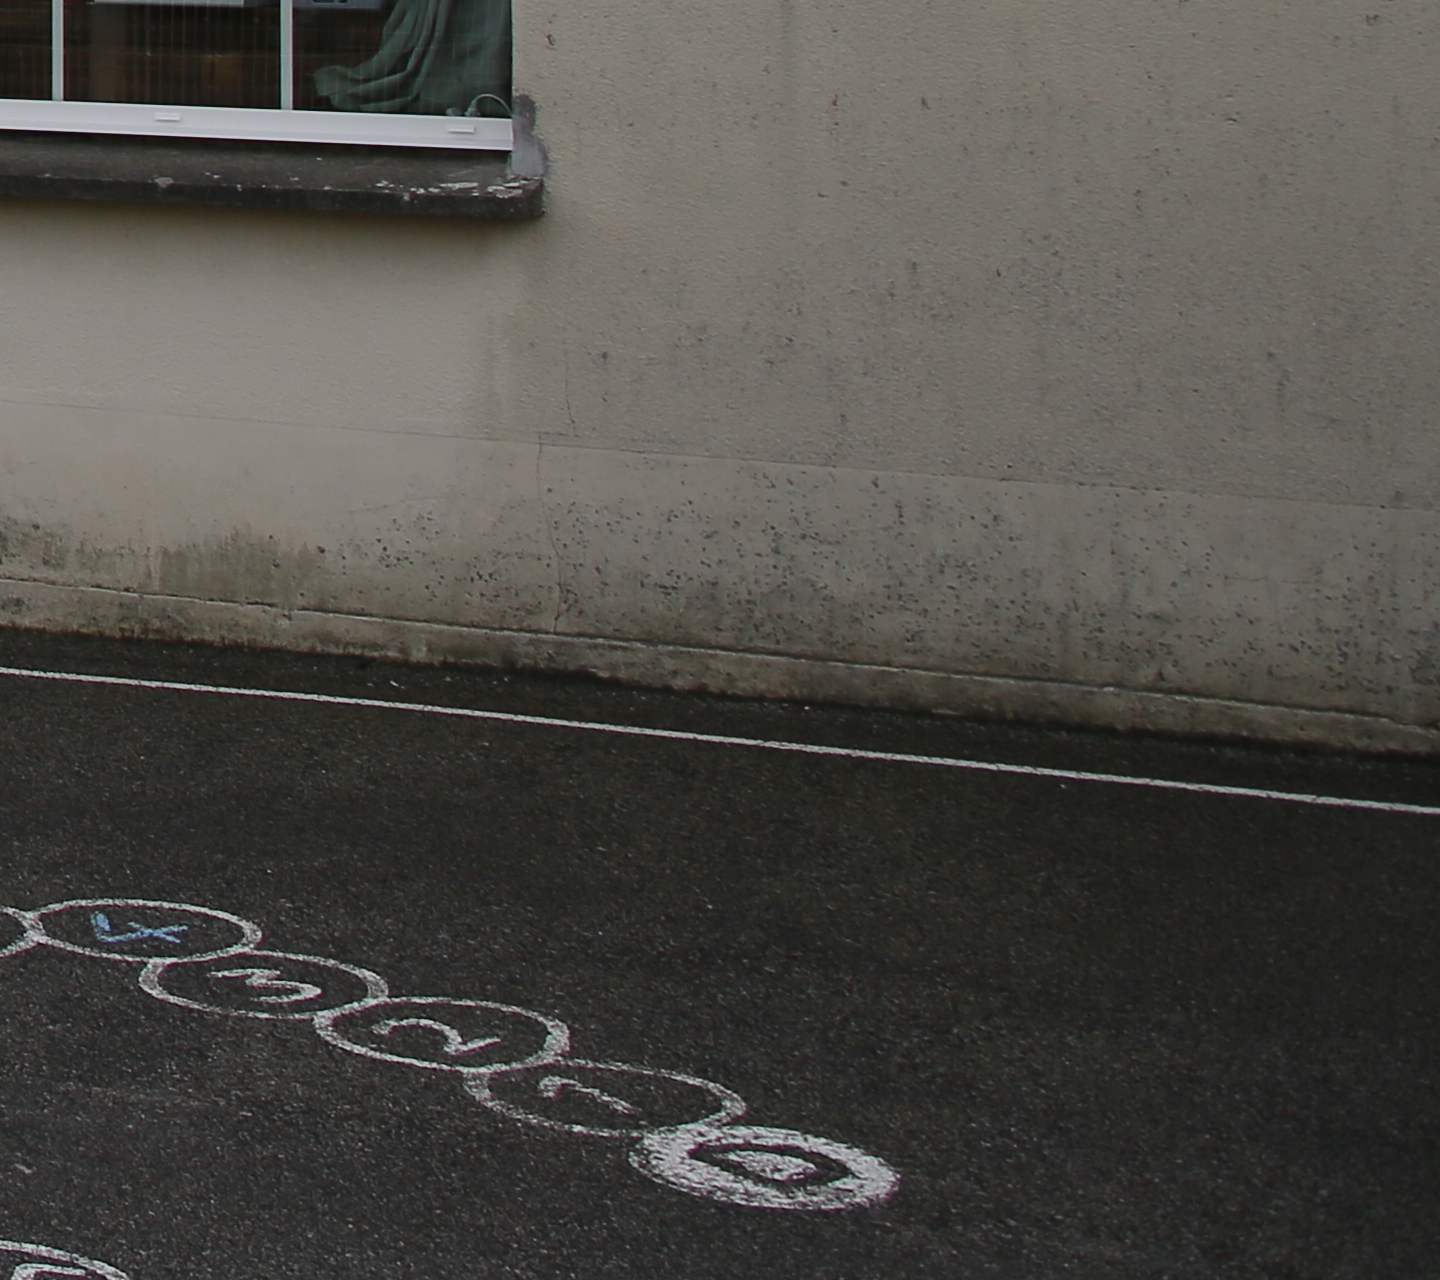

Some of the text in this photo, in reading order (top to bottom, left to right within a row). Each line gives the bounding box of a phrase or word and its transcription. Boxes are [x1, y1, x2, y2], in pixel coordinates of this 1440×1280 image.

[208, 968, 321, 1002] 3
[372, 1017, 501, 1055] 2
[537, 1076, 637, 1114] 1
